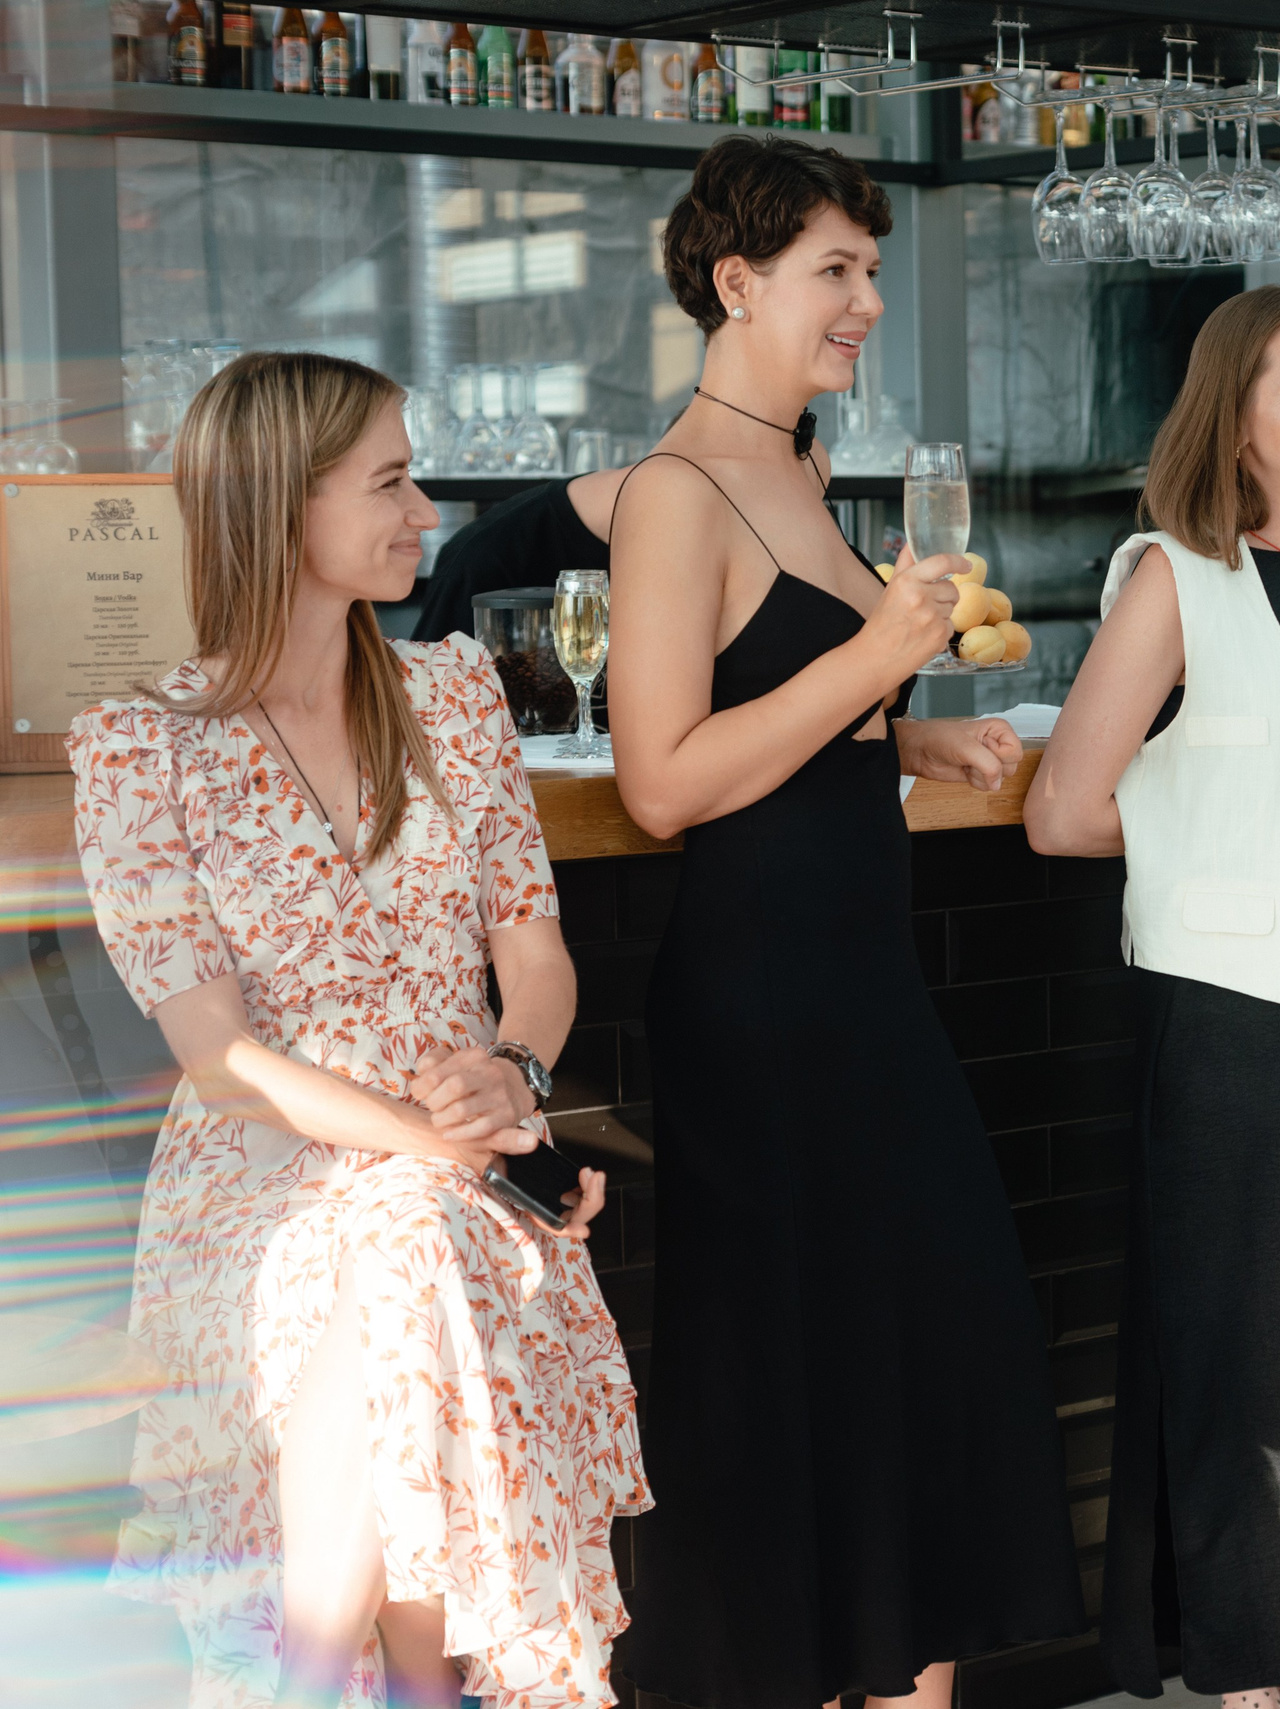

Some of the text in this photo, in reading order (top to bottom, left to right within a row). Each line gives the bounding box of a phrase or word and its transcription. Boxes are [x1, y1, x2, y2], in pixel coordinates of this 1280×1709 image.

[68, 526, 160, 542] PASCAL
[86, 571, 143, 583] Мини Бар
[94, 594, 113, 602] Водка
